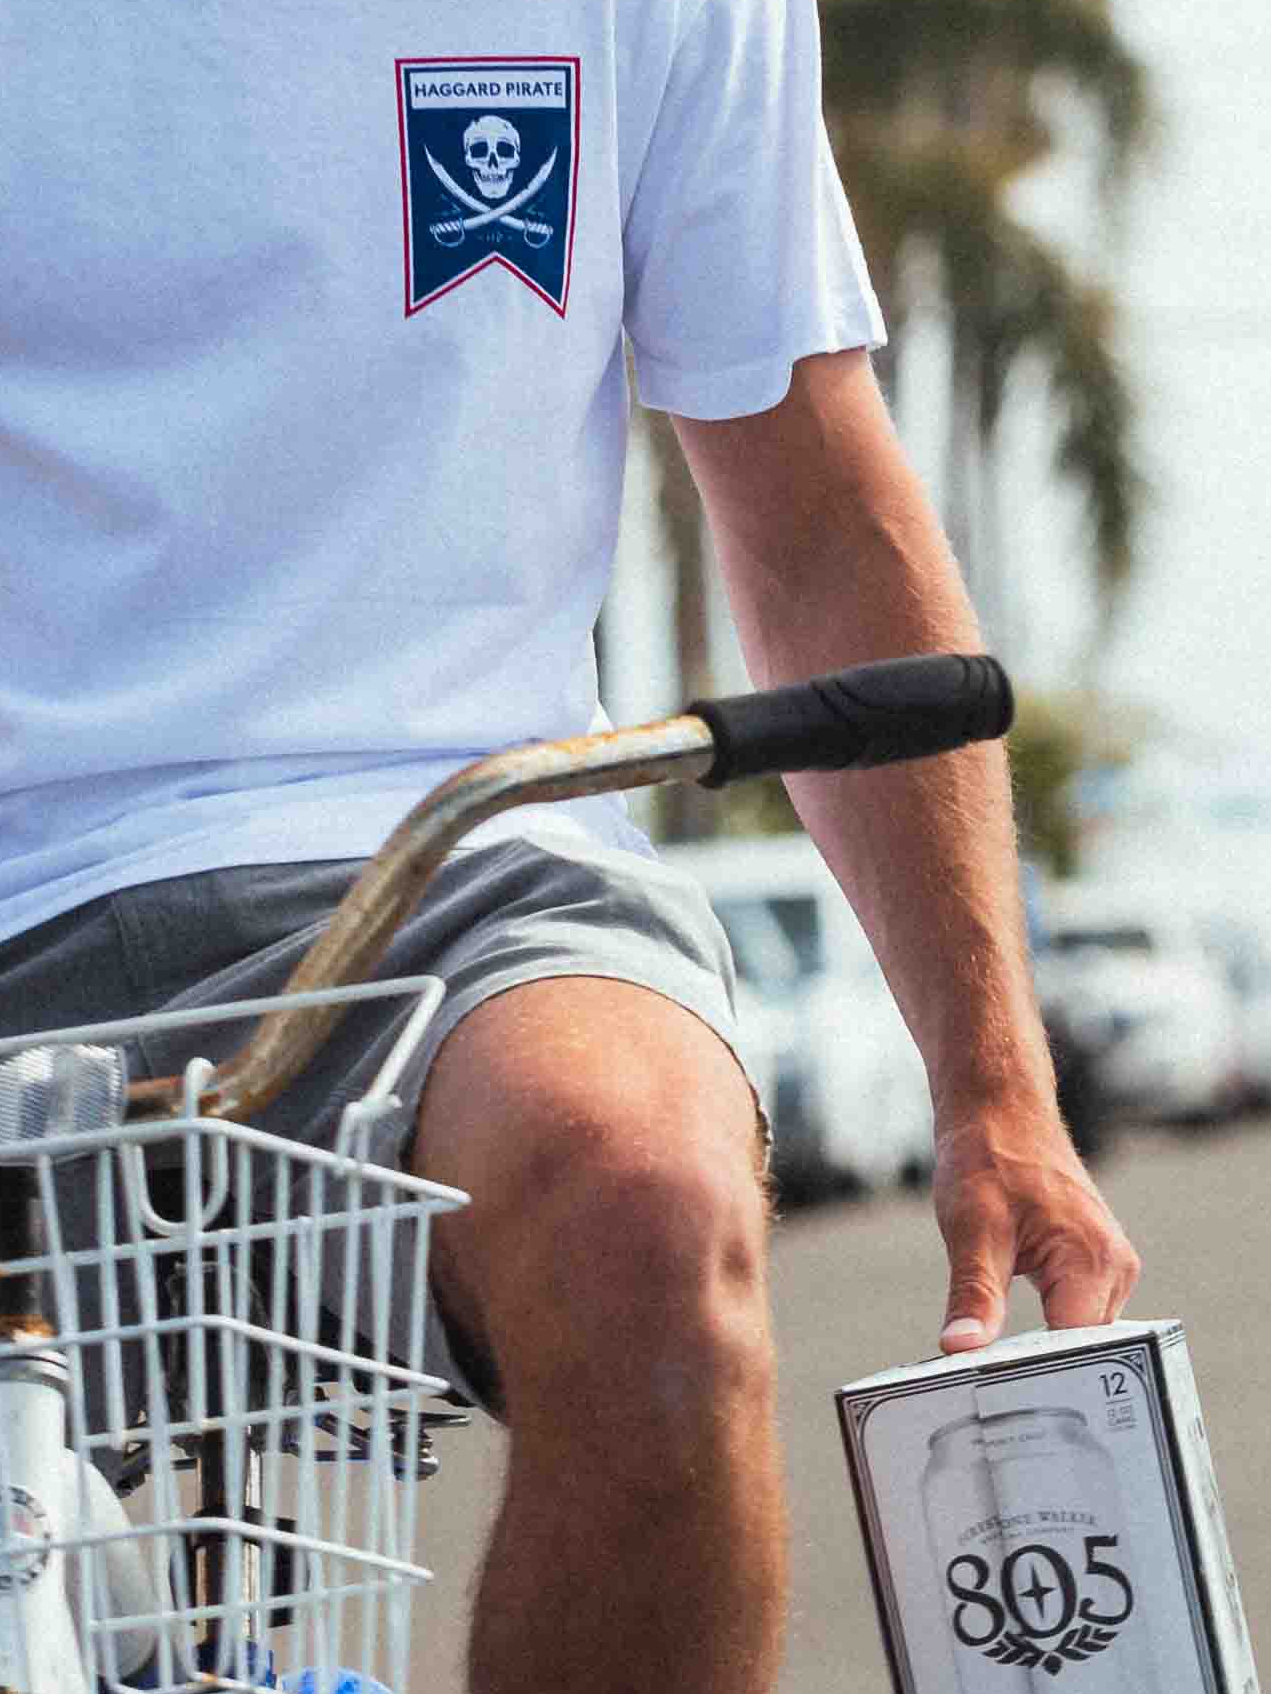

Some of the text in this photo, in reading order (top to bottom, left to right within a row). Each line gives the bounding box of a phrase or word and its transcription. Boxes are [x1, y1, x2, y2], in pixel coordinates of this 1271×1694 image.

[414, 81, 563, 97] HAGGARD PIRATE
[1099, 1371, 1128, 1398] 12
[946, 1533, 1134, 1647] 805
